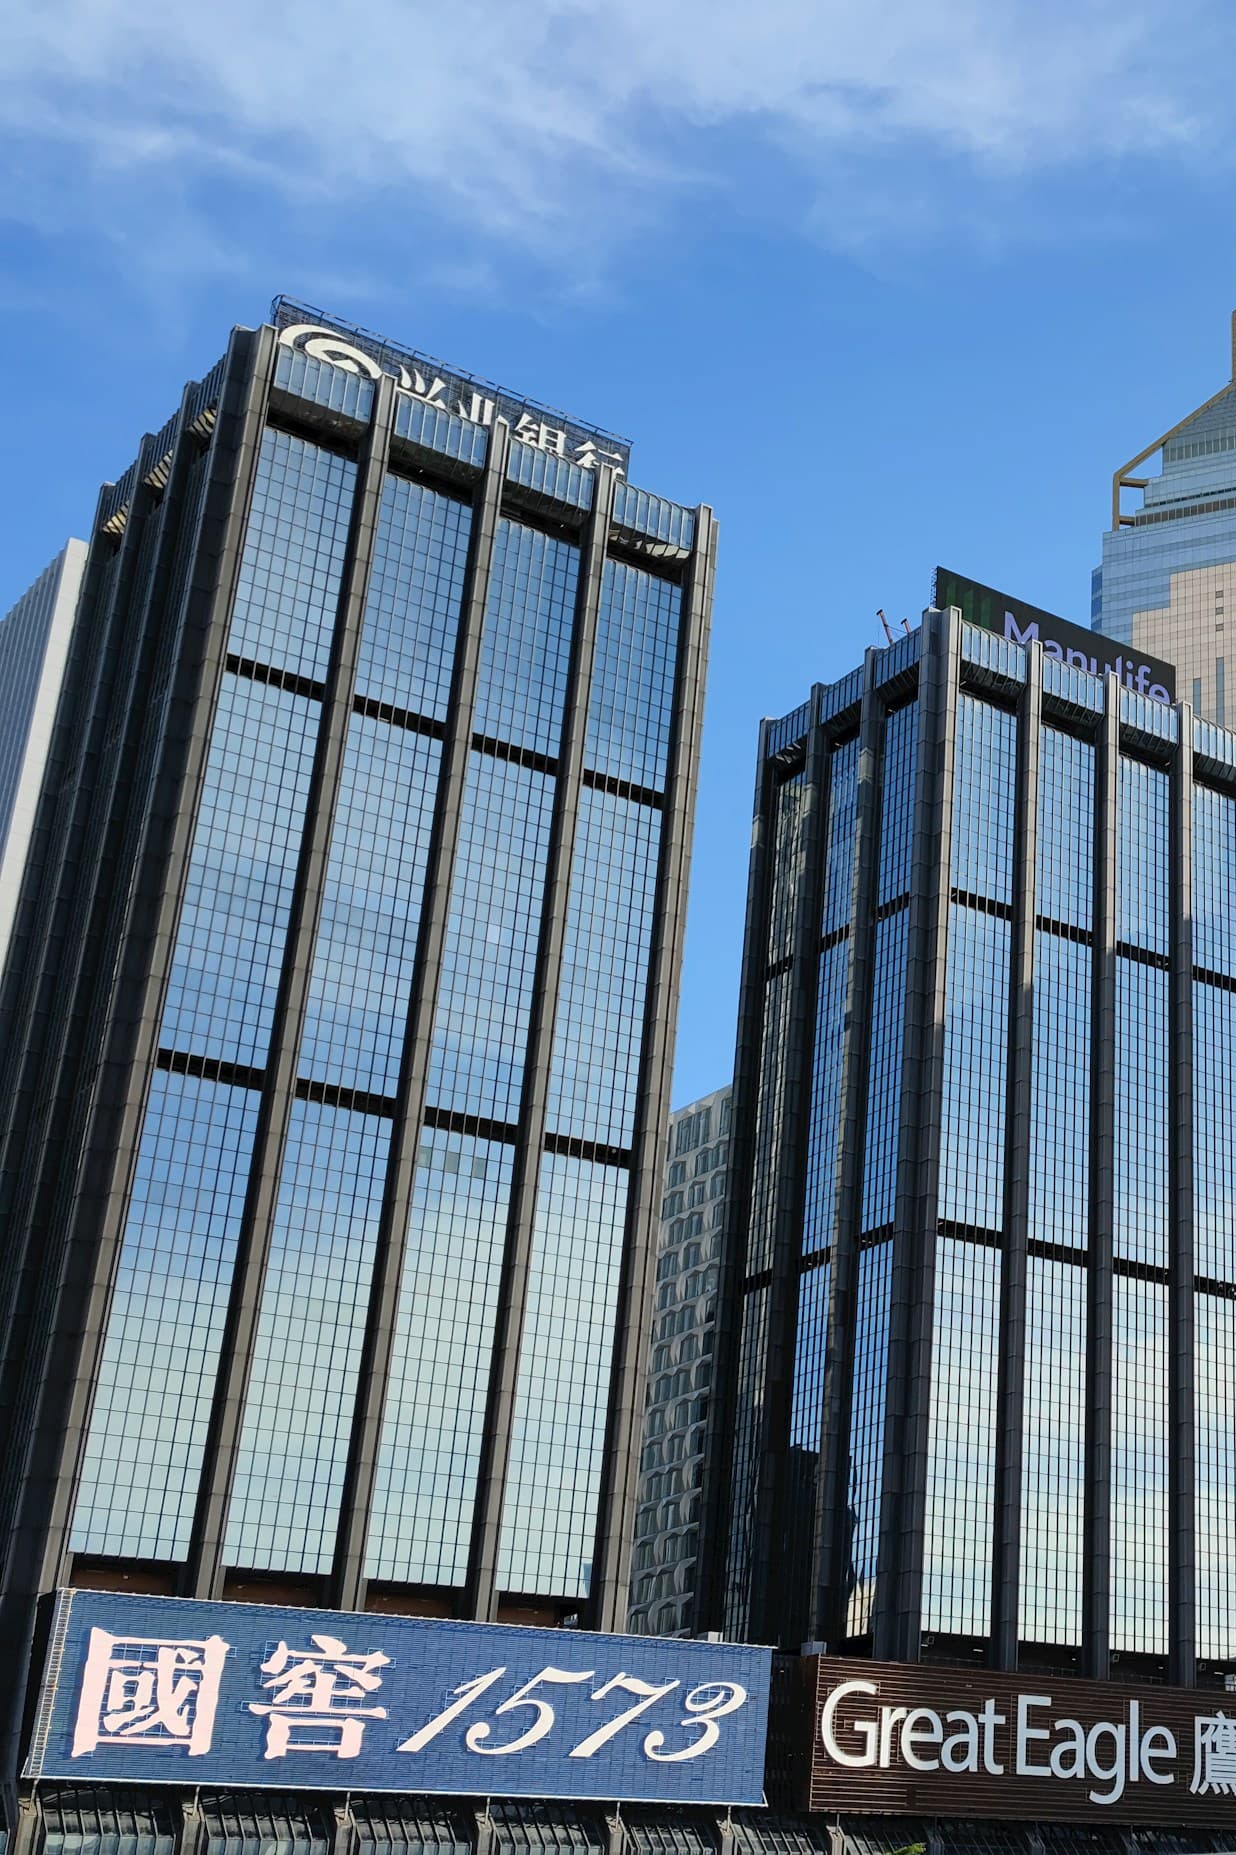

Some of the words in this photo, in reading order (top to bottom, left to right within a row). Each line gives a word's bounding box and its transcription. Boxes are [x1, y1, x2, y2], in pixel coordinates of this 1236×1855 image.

[72, 1626, 391, 1760] 國窖
[397, 1667, 747, 1762] 1573
[822, 1680, 1006, 1775] Great
[1016, 1695, 1176, 1804] Eagle
